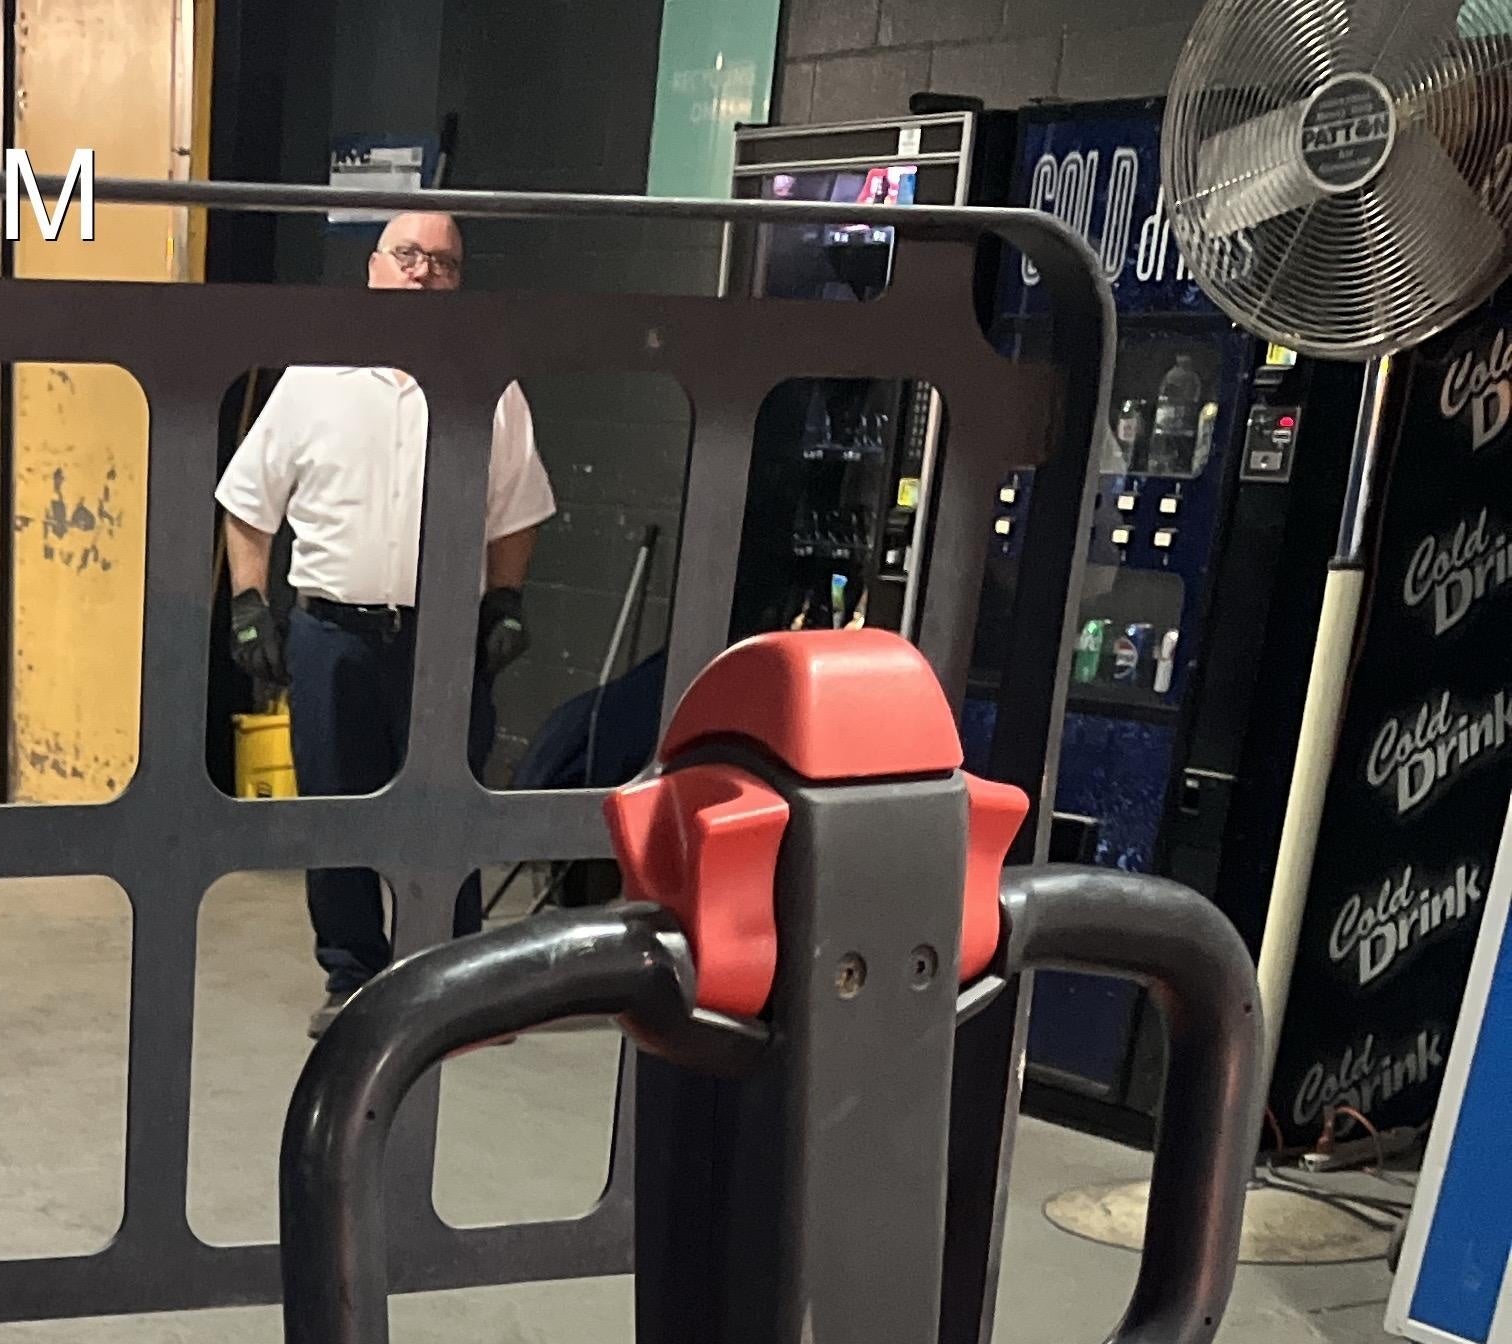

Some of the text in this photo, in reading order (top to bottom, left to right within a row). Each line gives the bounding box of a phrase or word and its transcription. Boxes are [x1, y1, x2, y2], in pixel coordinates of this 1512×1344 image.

[1403, 506, 1490, 606] Cold
[1367, 691, 1453, 786] Cold
[1329, 865, 1416, 961] Cold
[1359, 864, 1481, 985] Drink
[1293, 1033, 1375, 1126] Cold
